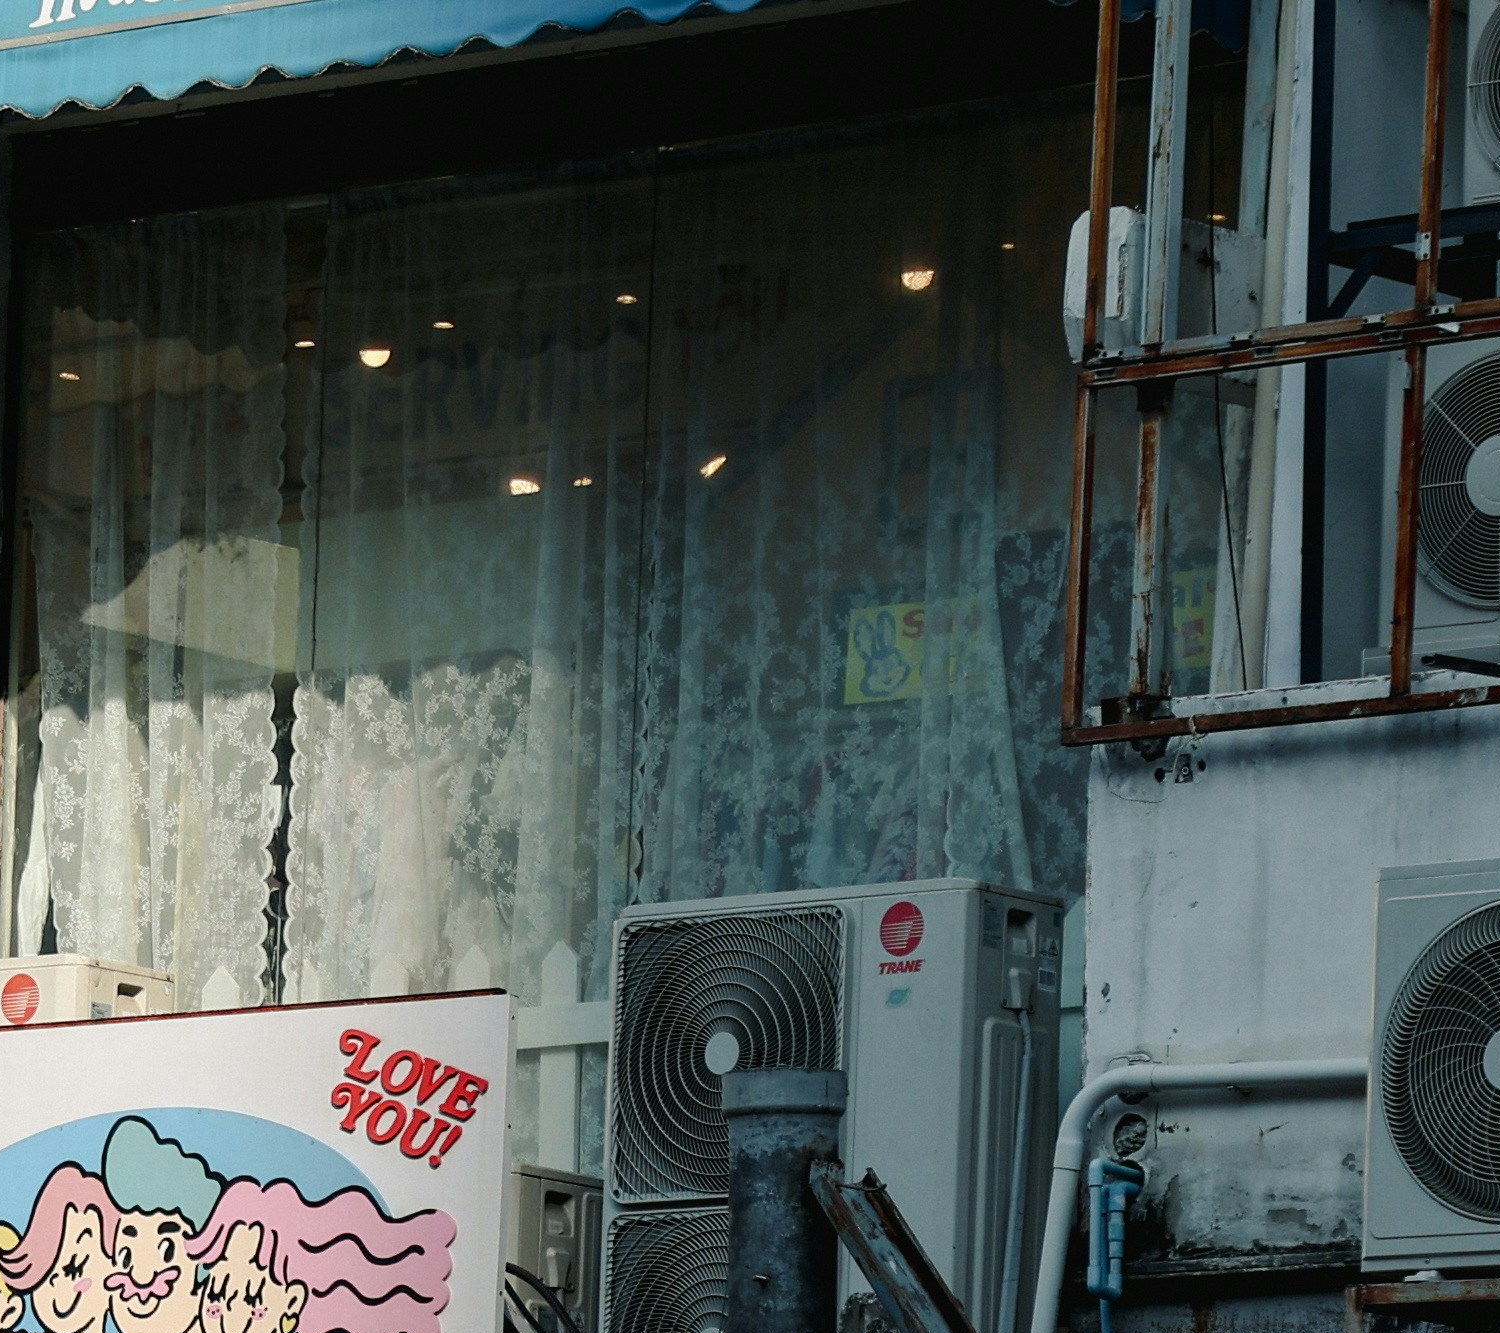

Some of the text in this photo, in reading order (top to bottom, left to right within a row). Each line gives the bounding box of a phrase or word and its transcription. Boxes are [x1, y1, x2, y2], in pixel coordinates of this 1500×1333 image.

[878, 958, 926, 976] TRANE
[338, 1028, 490, 1121] LOVE
[330, 1080, 464, 1169] YOU!
